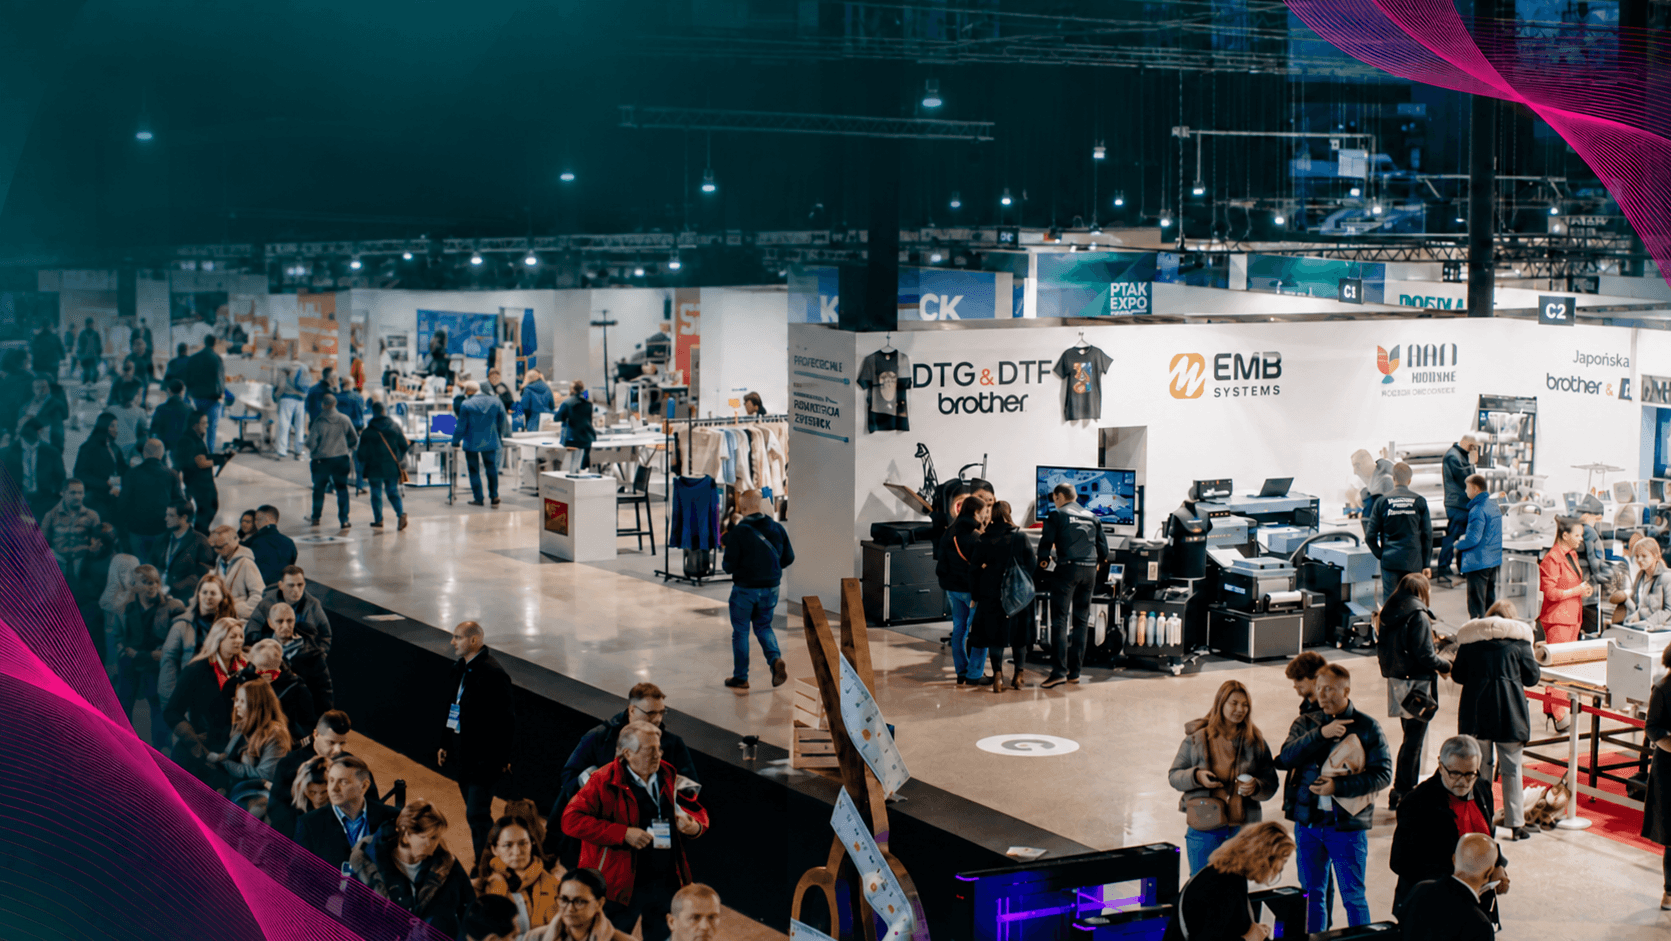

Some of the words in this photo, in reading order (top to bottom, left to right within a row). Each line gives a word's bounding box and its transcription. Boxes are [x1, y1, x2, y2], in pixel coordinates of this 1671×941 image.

[1110, 282, 1147, 297] PTAK
[1110, 297, 1147, 311] EXPO
[1545, 303, 1567, 319] C2
[912, 361, 976, 389] DTG
[979, 368, 995, 386] &
[998, 360, 1052, 385] DTF
[1213, 351, 1282, 381] EMB
[1213, 384, 1281, 398] SYSTEMS
[1546, 372, 1602, 395] brother
[1605, 382, 1614, 396] &
[937, 391, 1029, 415] brother
